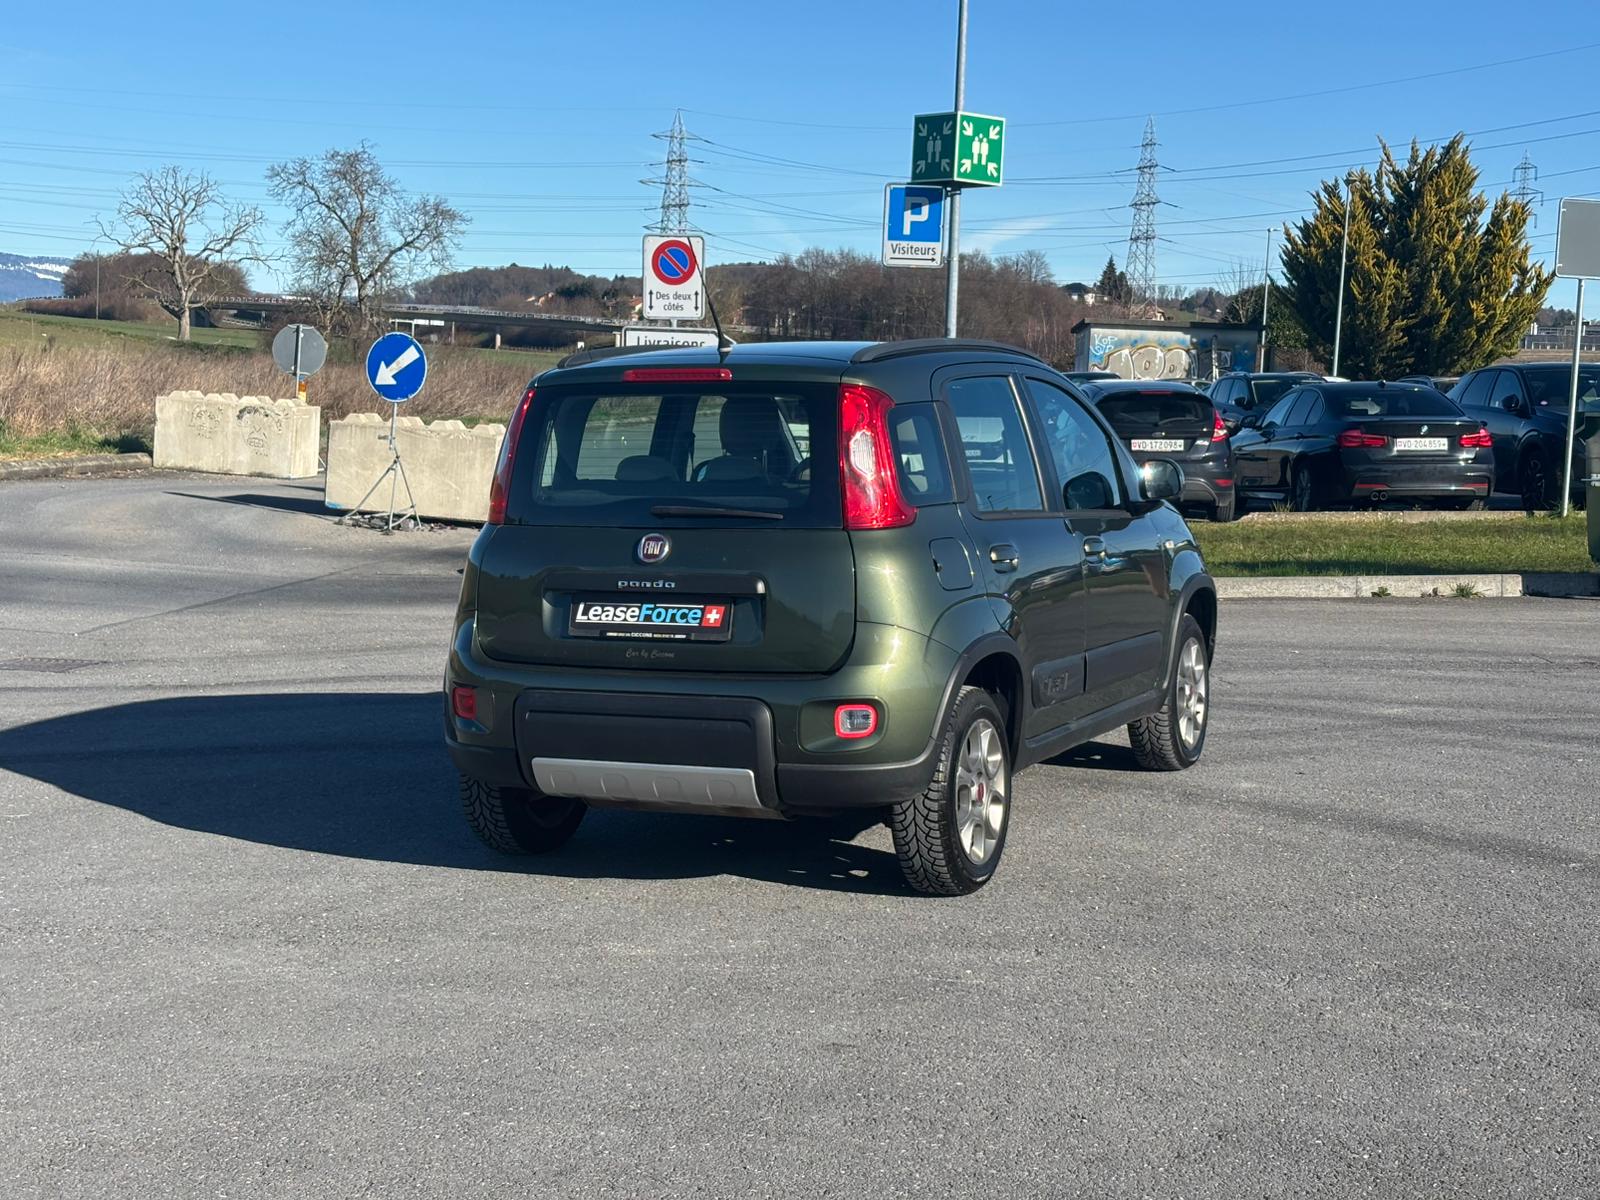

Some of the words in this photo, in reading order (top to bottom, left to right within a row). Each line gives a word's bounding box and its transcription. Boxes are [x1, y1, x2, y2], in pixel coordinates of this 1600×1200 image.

[903, 196, 930, 235] P
[891, 243, 937, 256] Visiteurs
[655, 291, 670, 300] Des
[672, 291, 692, 301] deux
[663, 302, 684, 311] côtés
[644, 540, 663, 555] FIAT
[575, 602, 702, 624] LeaseForce
